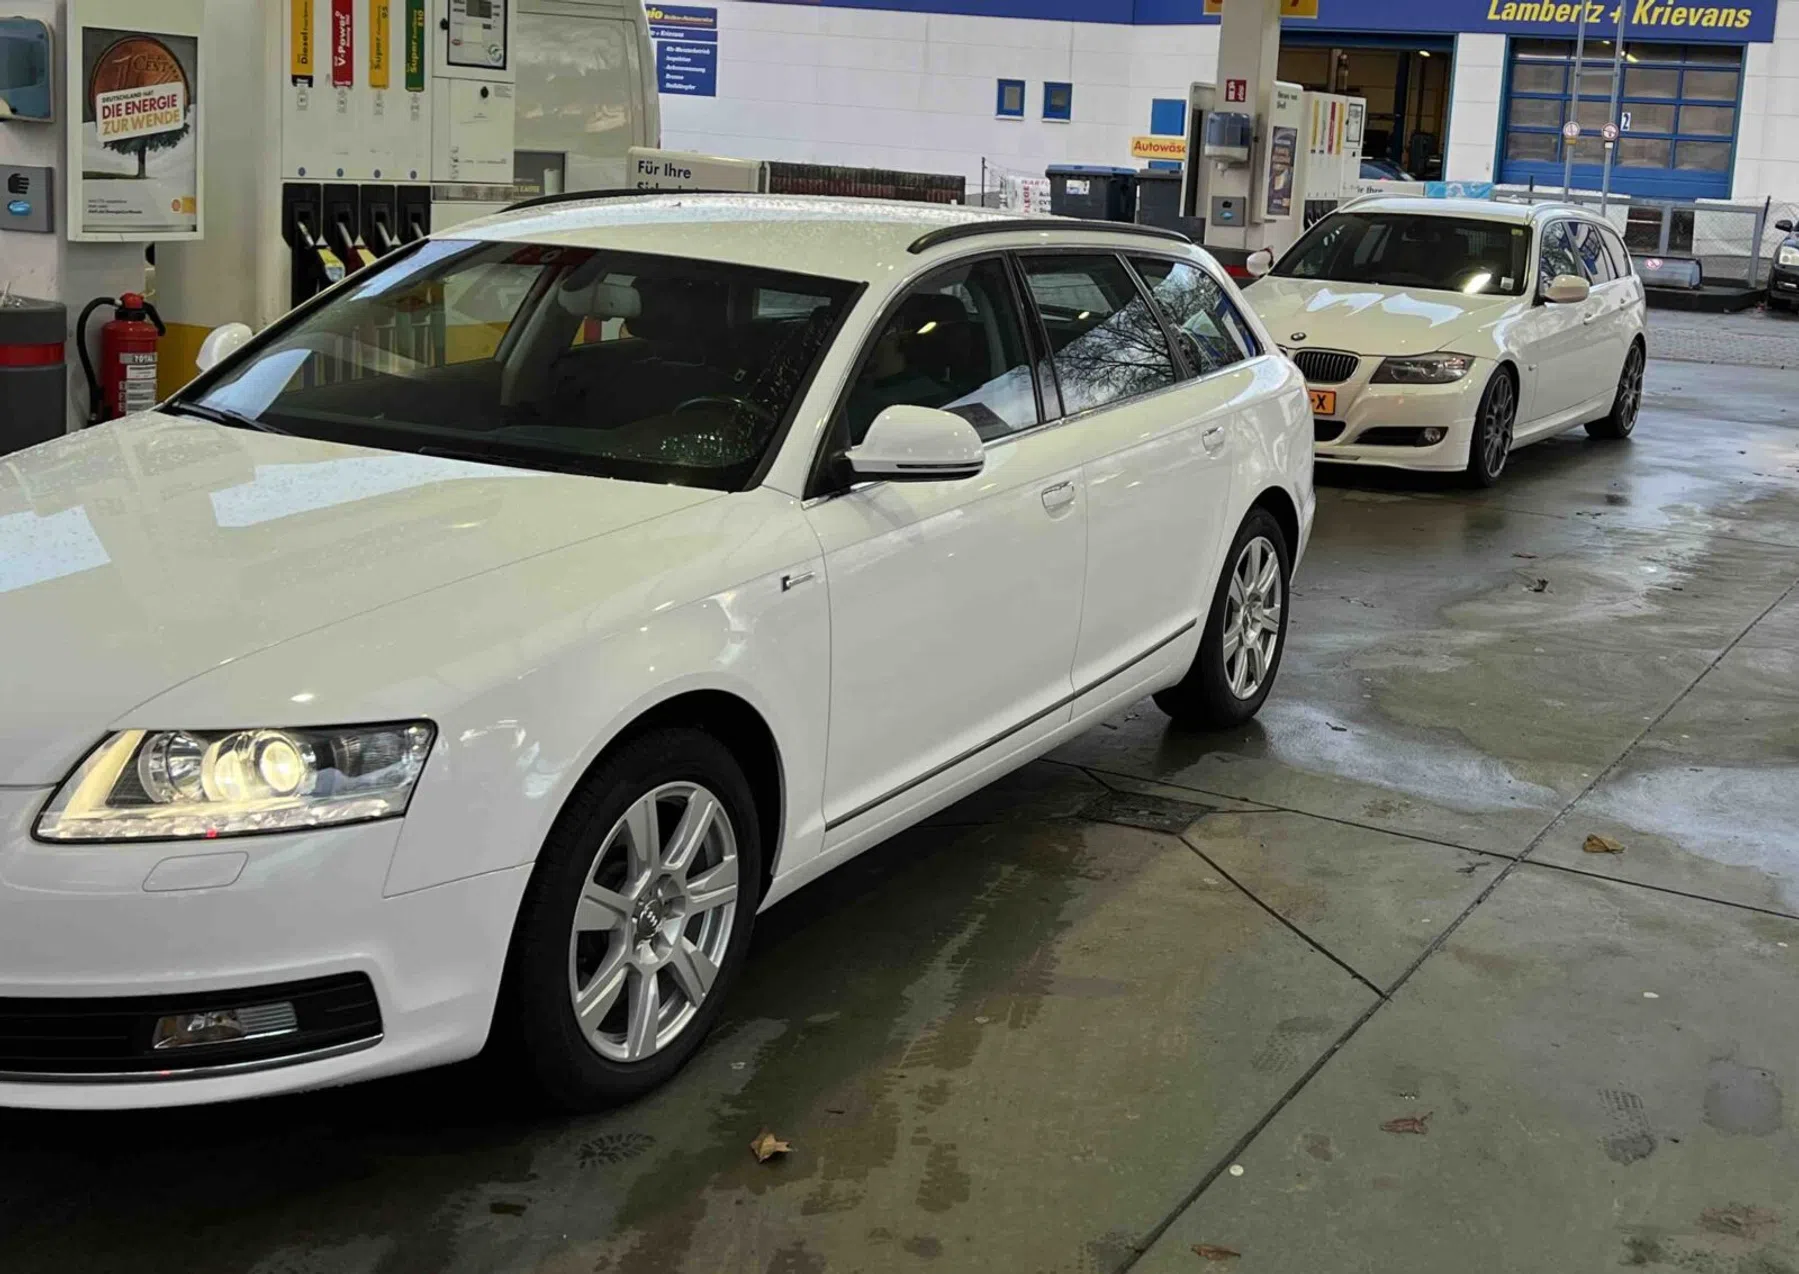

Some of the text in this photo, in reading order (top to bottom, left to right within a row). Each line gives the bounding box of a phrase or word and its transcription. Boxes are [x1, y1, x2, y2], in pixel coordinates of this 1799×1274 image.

[1487, 0, 1605, 23] Lambertz
[1632, 0, 1752, 28] Krievans
[300, 31, 308, 64] Diesel
[411, 41, 419, 72] Super
[102, 94, 177, 119] DIE ENERGIE
[102, 109, 181, 136] ZUR WENDE
[1622, 113, 1629, 129] 2
[638, 160, 692, 179] Für Ihre
